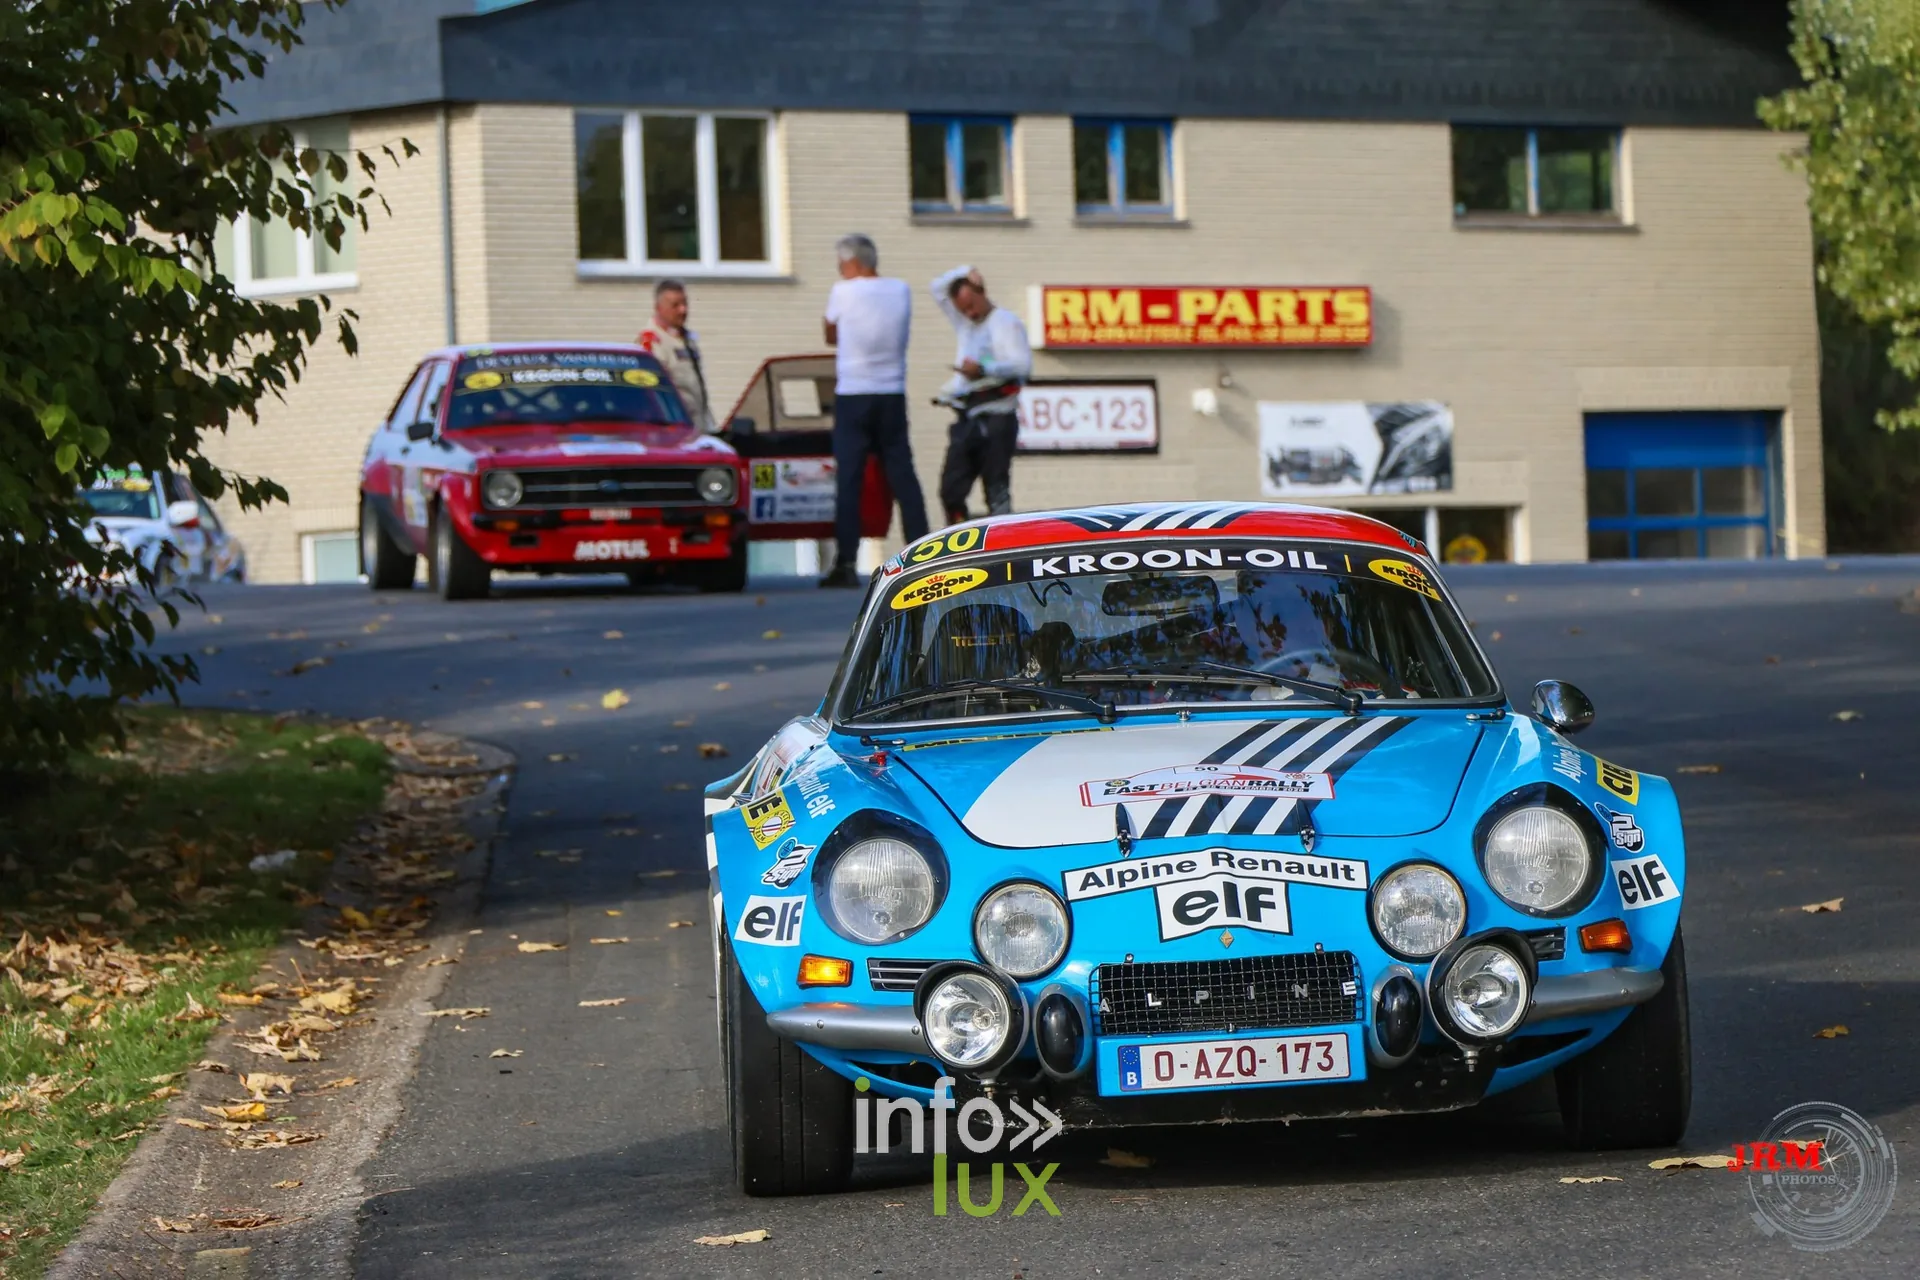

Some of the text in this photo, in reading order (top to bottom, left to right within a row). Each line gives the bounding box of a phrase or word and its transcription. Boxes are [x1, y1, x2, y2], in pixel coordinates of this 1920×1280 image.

[573, 538, 651, 561] MOTUL
[911, 527, 980, 562] 50
[1032, 548, 1328, 577] KROON-OIL
[903, 574, 974, 602] KROON
[921, 588, 953, 602] OIL
[1402, 579, 1432, 596] OIL
[1103, 783, 1161, 796] EAST
[1160, 778, 1246, 790] BELGIAN
[1247, 779, 1316, 790] RALLY
[806, 794, 836, 819] elf
[1079, 851, 1356, 892] Alpine Renault
[1618, 860, 1667, 905] elf
[1172, 880, 1277, 926] elf
[744, 901, 803, 941] elf
[1126, 1071, 1138, 1086] B
